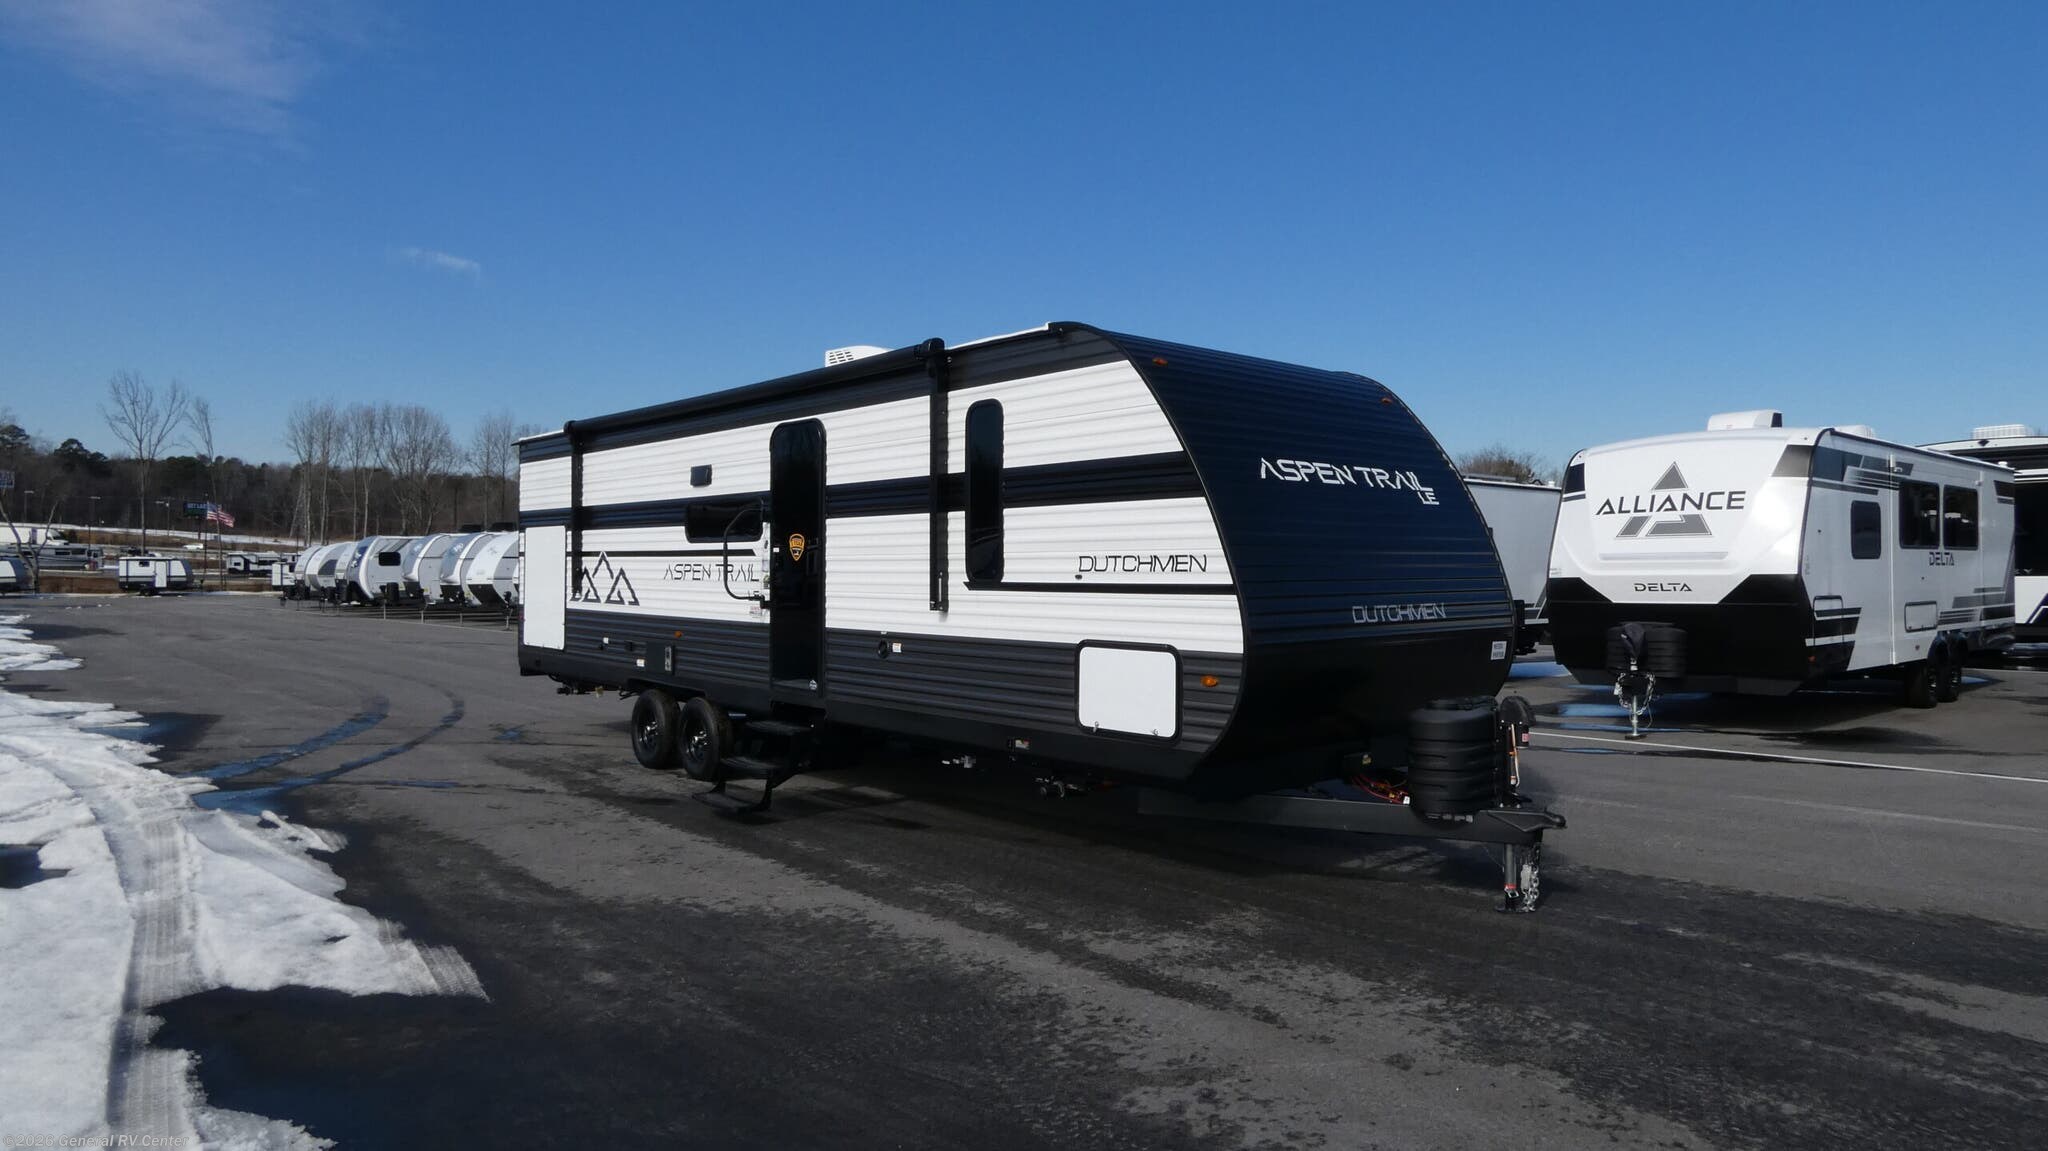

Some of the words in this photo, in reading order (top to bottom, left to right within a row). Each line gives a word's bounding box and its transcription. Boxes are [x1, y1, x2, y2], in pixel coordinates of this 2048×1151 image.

[1261, 457, 1357, 485] ASPEN
[1353, 466, 1433, 491] TRAIL
[1417, 491, 1440, 505] LE
[1595, 491, 1746, 515] ALLIANCE
[1078, 554, 1207, 572] DUTCHMEN
[1929, 551, 1955, 566] DELTA
[663, 563, 712, 581] ASPEN
[715, 563, 760, 582] TRAIL
[1633, 582, 1693, 592] DELTA
[1352, 603, 1446, 623] DUTCHMEN
